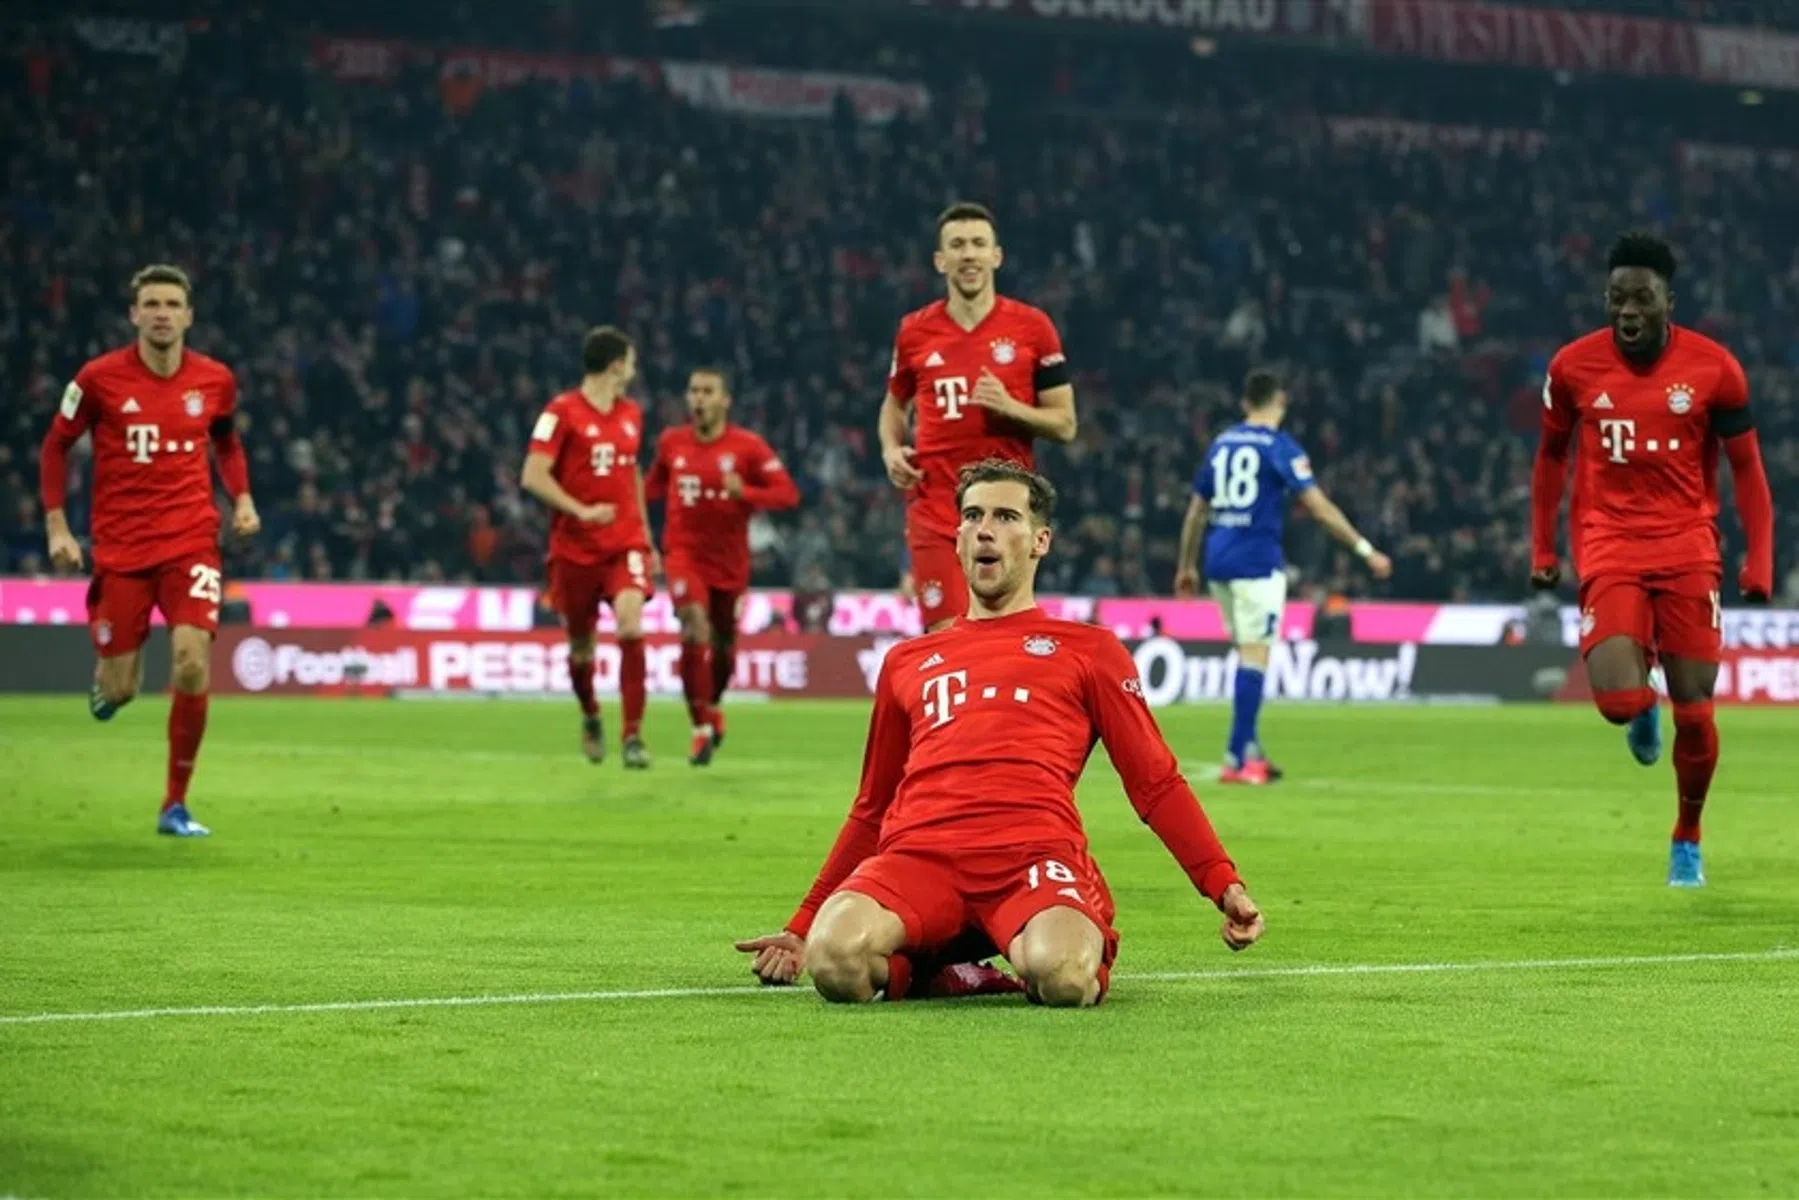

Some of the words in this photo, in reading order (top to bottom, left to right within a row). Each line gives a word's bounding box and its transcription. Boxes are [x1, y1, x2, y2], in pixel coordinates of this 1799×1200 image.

[1210, 445, 1260, 509] 18
[189, 563, 221, 604] 25
[729, 650, 807, 690] ITE
[1265, 640, 1417, 701] Now!
[1028, 859, 1076, 889] 18
